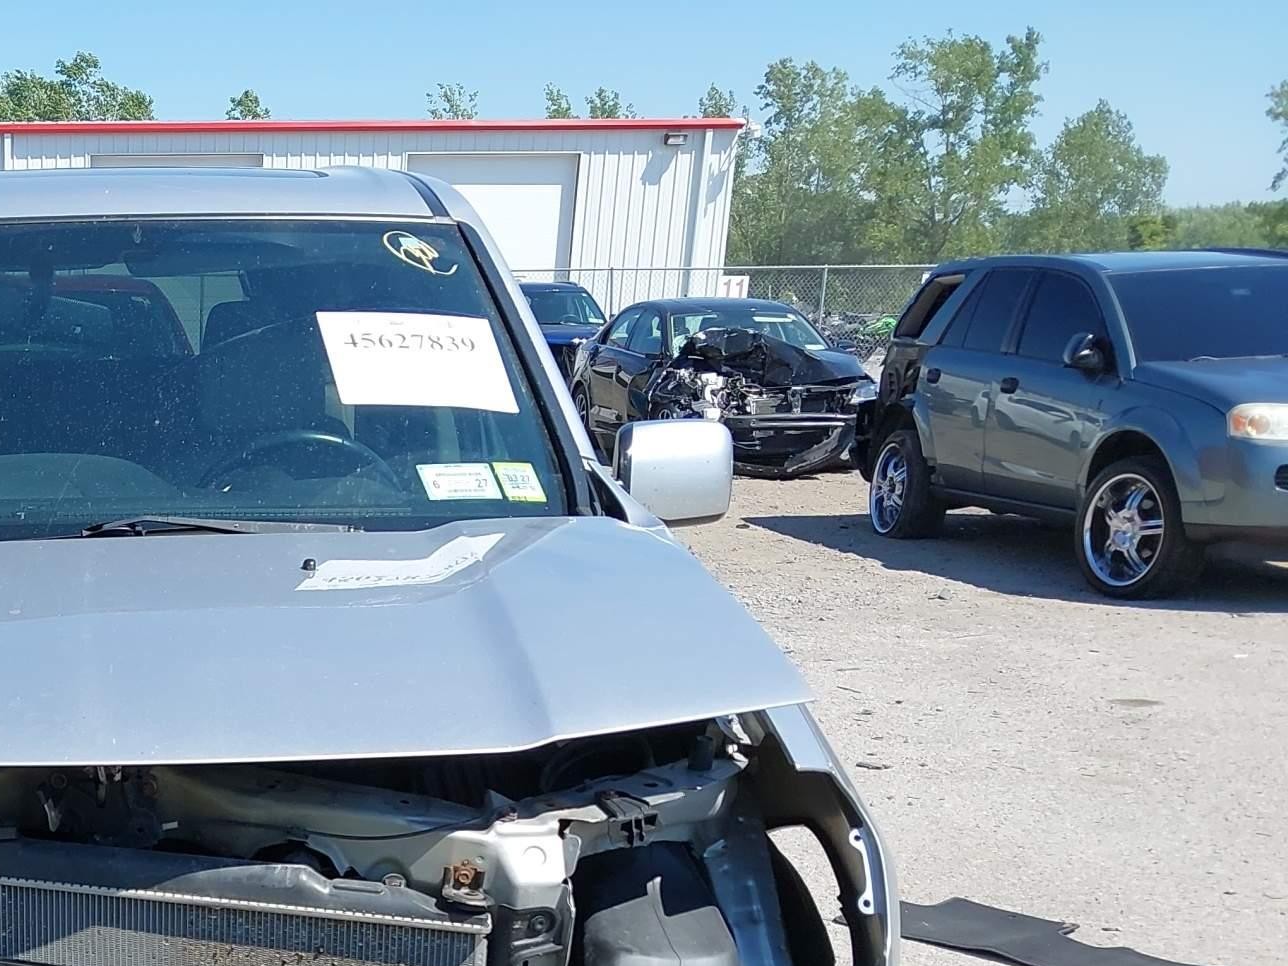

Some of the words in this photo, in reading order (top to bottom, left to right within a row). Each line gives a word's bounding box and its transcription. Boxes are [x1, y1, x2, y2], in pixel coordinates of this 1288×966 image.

[723, 278, 744, 298] 11
[343, 332, 476, 352] 45627839
[475, 478, 489, 489] 27
